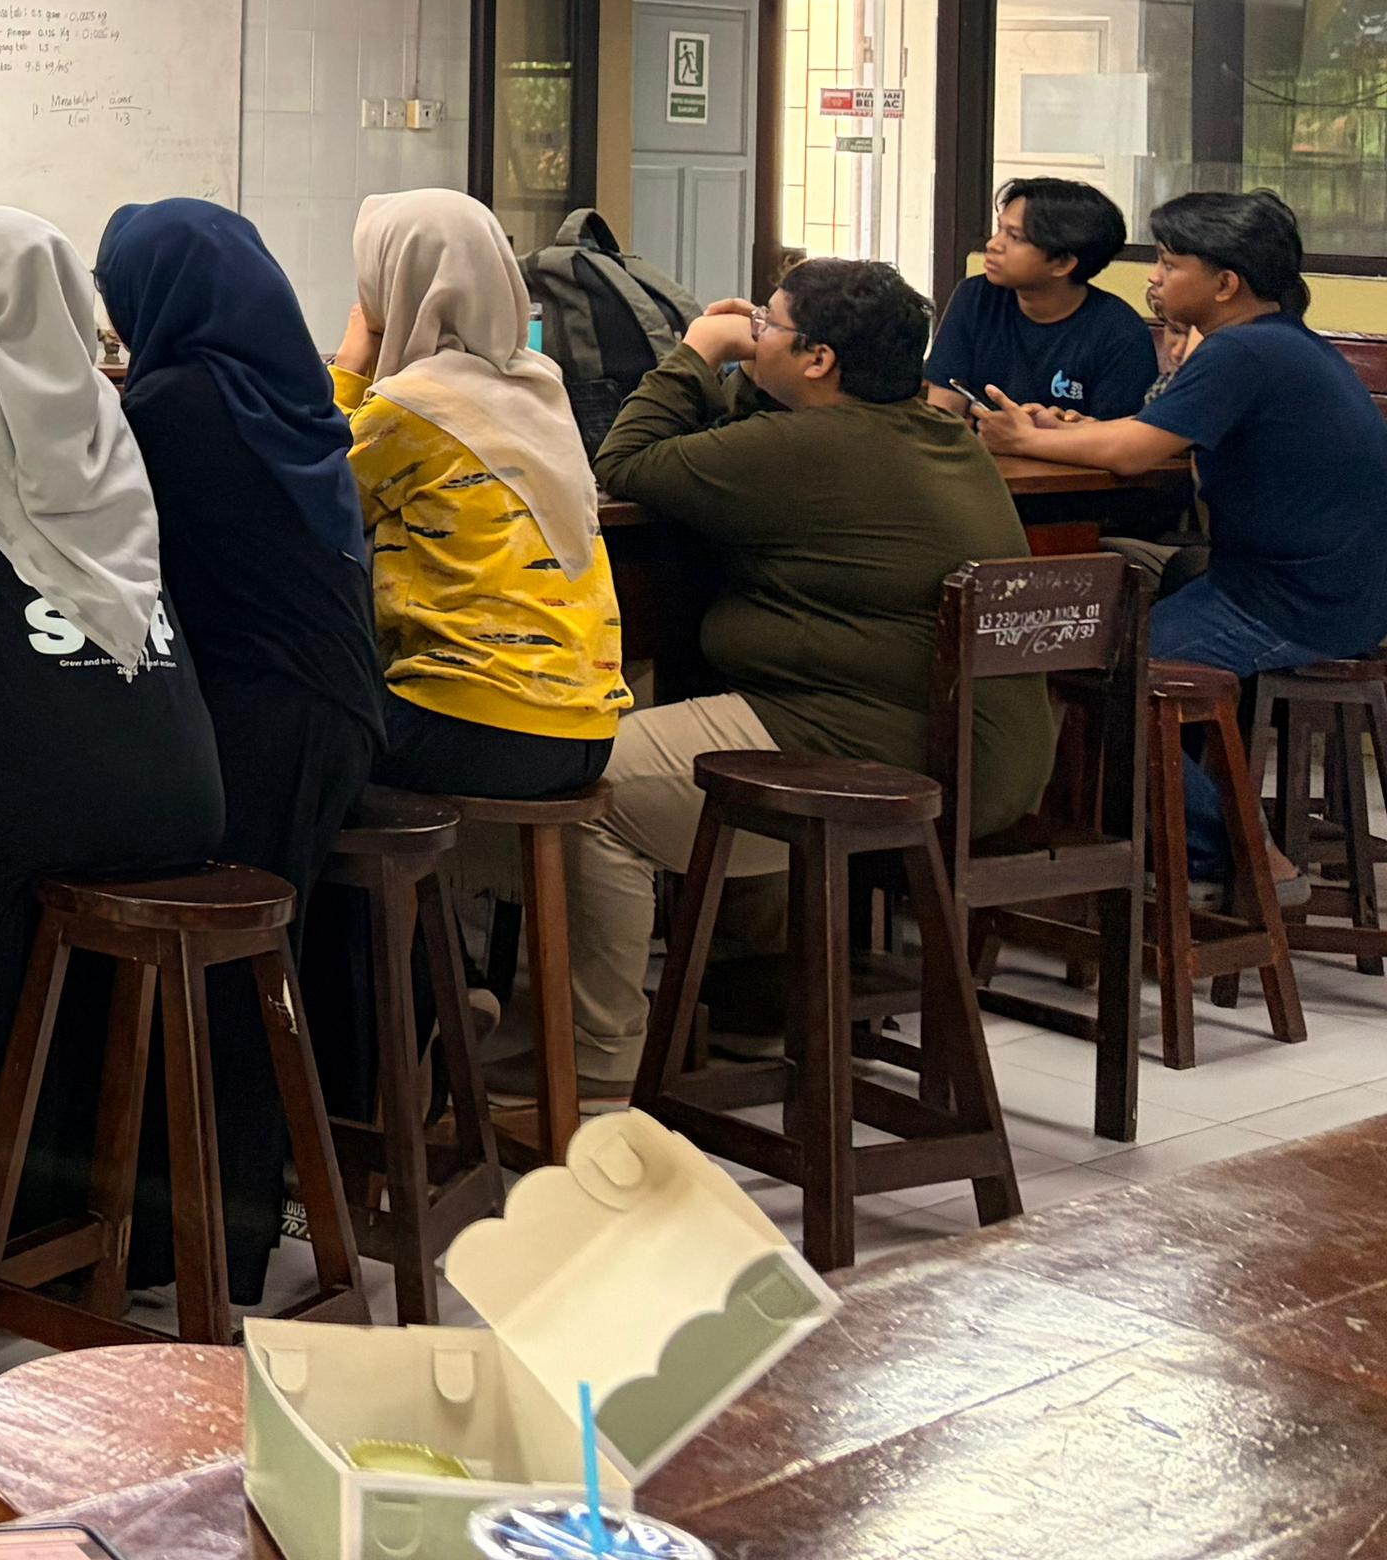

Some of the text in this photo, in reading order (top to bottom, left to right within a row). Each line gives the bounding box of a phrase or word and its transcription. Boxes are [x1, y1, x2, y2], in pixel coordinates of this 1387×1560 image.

[59, 659, 83, 667] Grow
[83, 657, 100, 667] and
[101, 657, 111, 666] be
